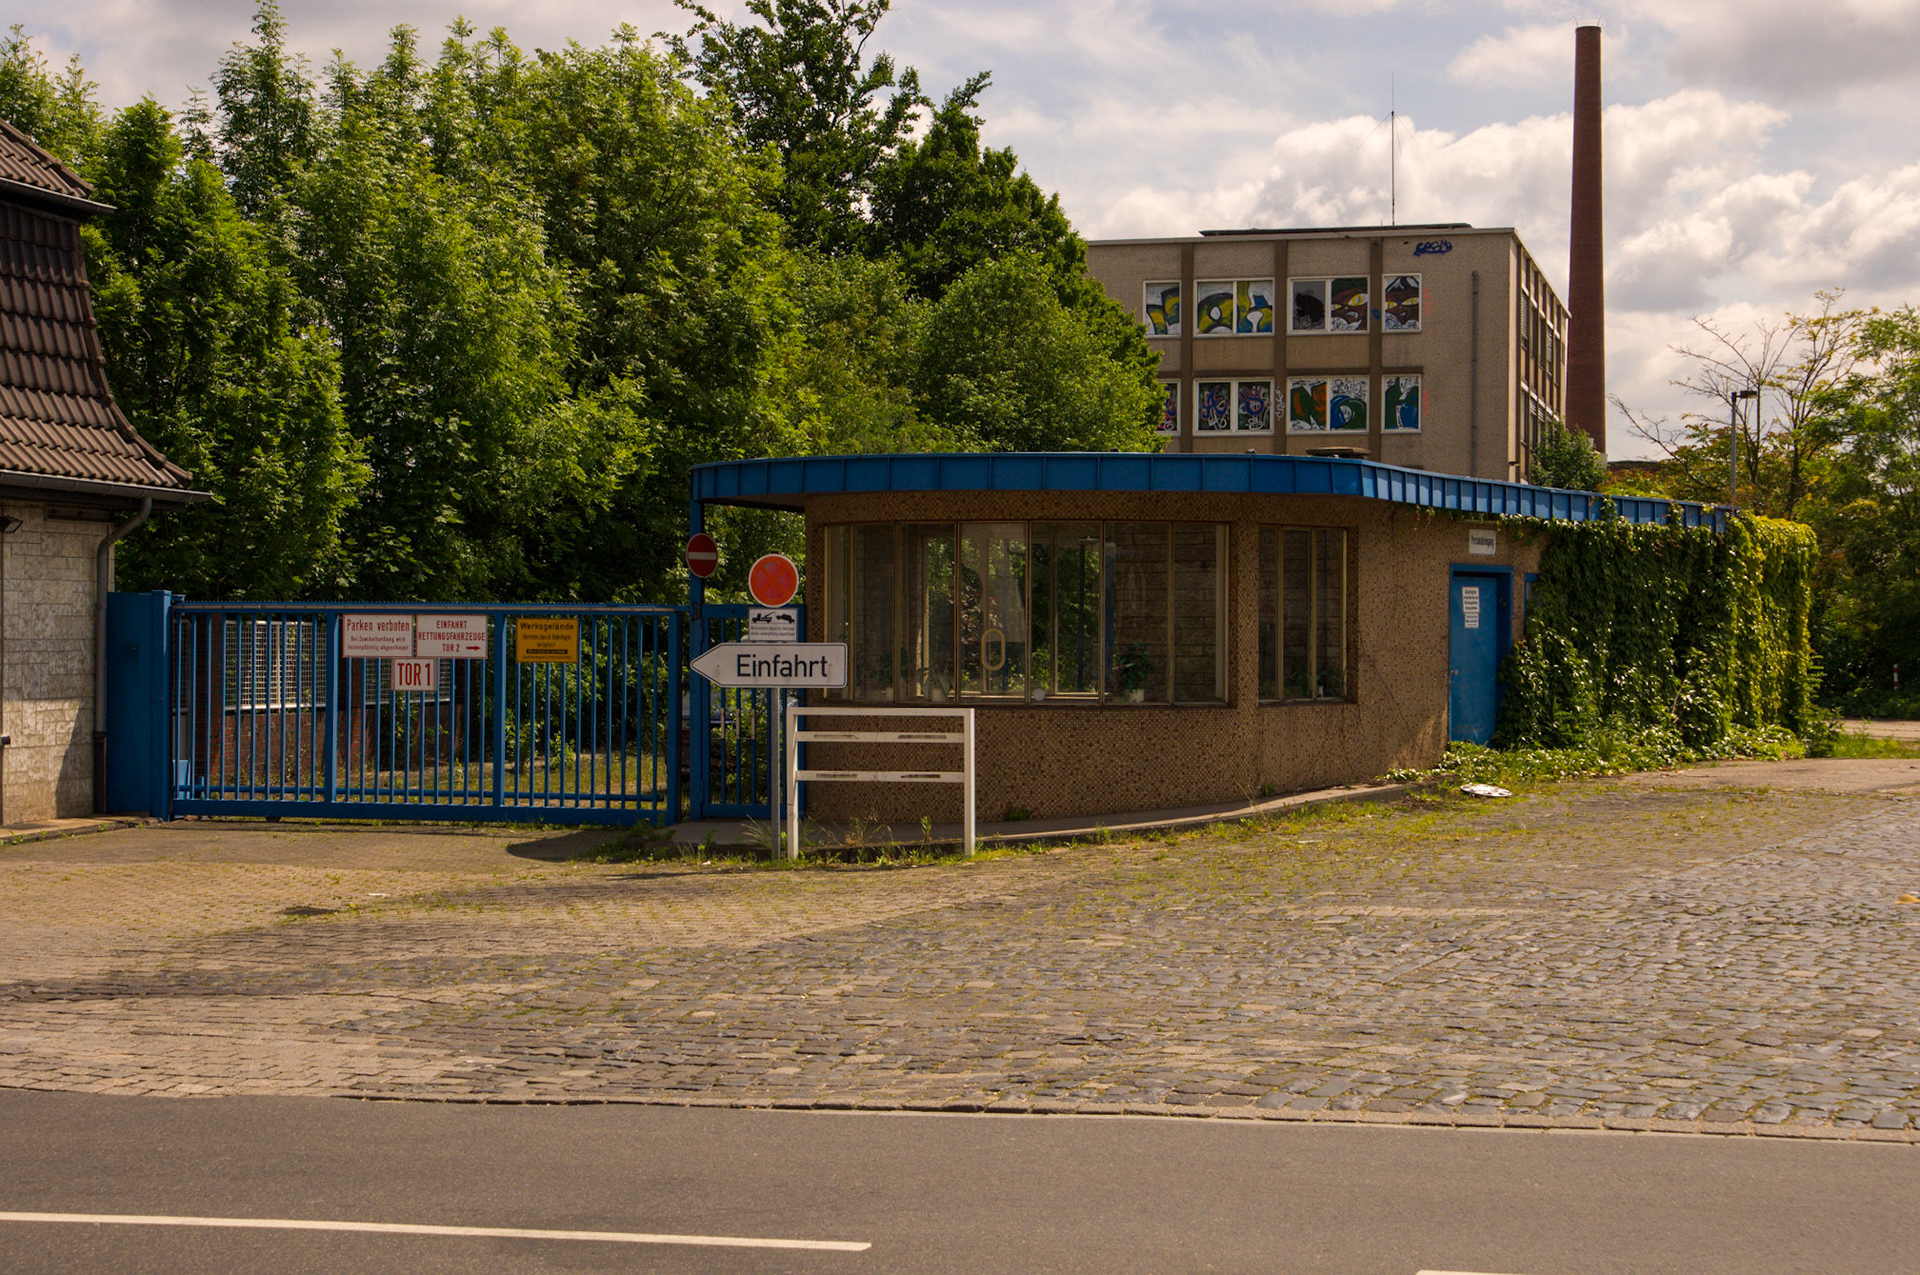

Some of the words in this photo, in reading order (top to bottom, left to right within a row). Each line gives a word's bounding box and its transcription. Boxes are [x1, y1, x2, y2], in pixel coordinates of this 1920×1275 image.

[347, 619, 373, 631] Parken
[377, 619, 410, 631] verboten
[436, 620, 468, 629] EINFAHRT
[520, 622, 574, 632] Werksgelände
[418, 631, 486, 641] RETTUNGSFAHRZEUGE
[442, 643, 455, 652] TOR
[456, 643, 460, 652] 2
[736, 654, 828, 678] Einfahrt
[397, 662, 422, 686] TOR
[425, 662, 431, 686] 1
